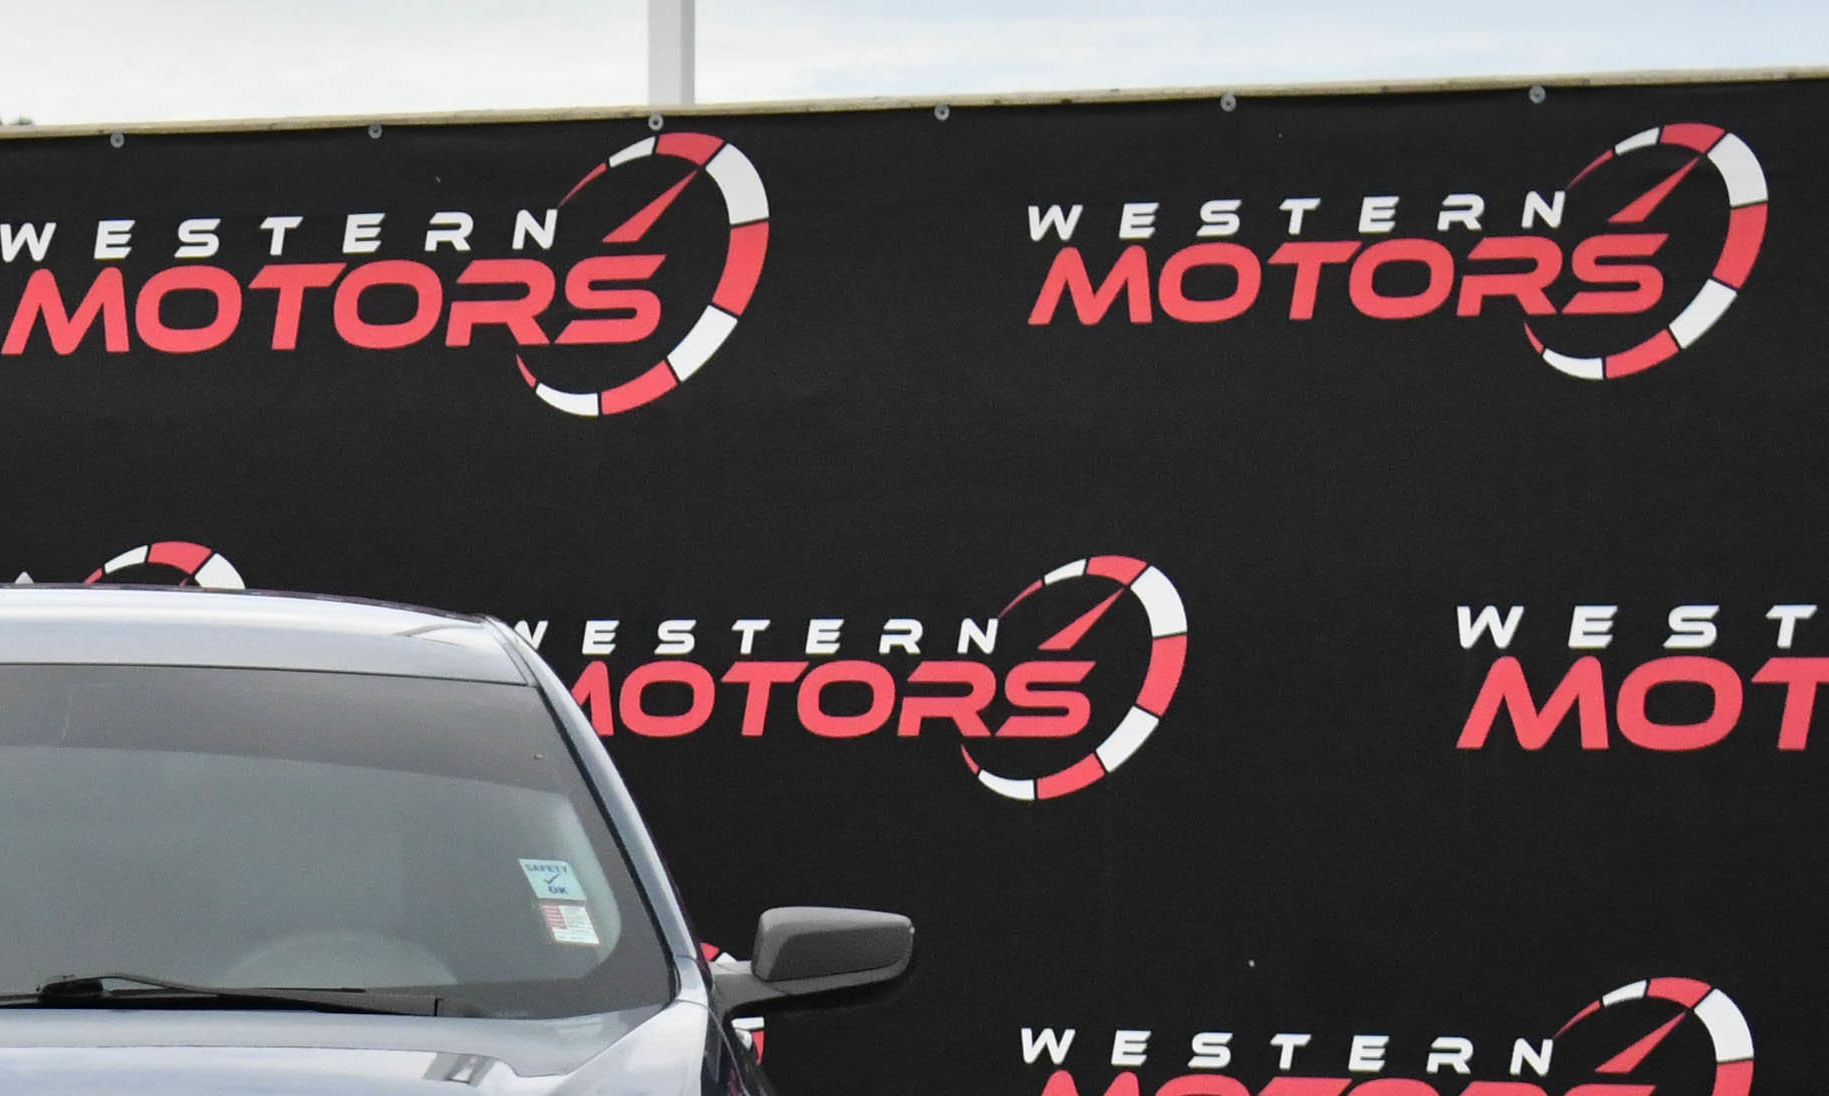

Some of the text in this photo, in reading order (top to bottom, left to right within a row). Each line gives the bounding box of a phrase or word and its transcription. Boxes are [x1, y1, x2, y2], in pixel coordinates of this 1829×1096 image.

[1, 210, 558, 262] WESTERN
[1030, 193, 1566, 242] WESTERN
[3, 256, 666, 356] MOTORS
[1030, 235, 1669, 328] MOTORS
[1458, 606, 1817, 649] WEST
[1023, 1029, 1554, 1076] WESTERN
